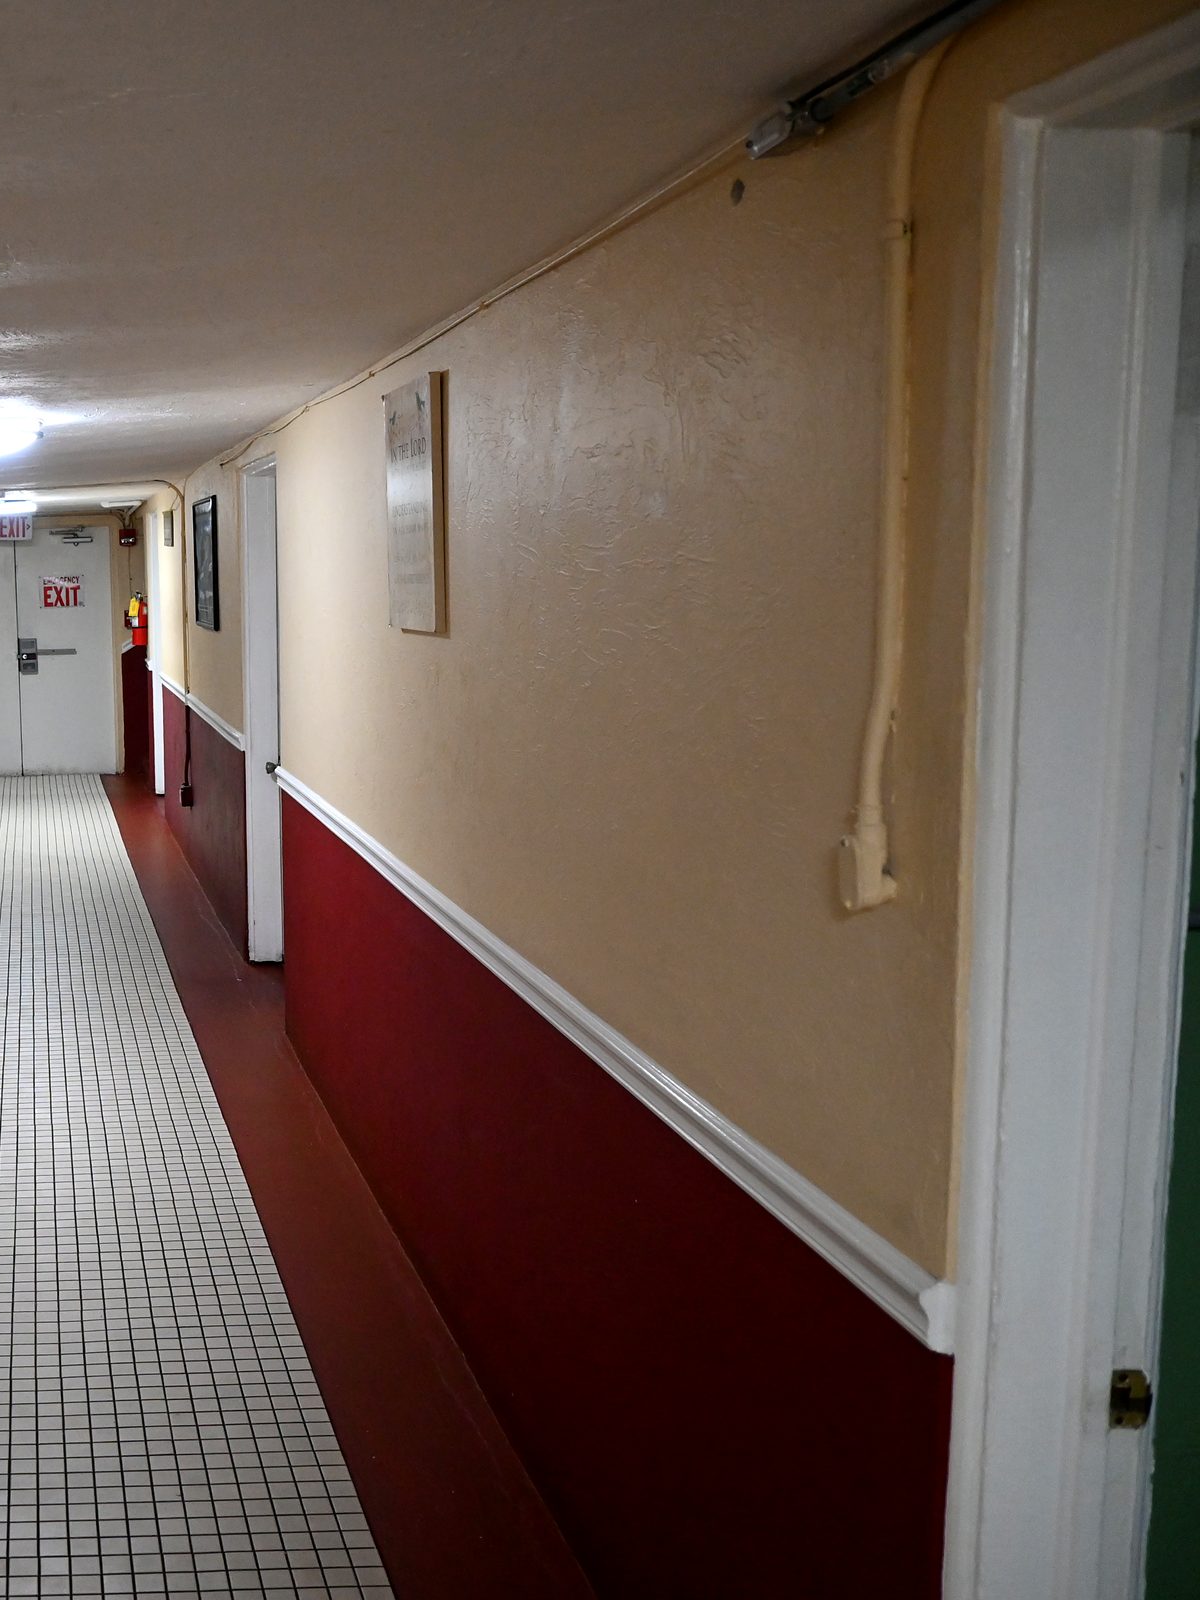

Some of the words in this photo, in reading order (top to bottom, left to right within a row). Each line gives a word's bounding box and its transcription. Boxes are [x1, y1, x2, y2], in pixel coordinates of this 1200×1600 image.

[399, 442, 409, 461] THE
[411, 434, 426, 457] LORD
[0, 516, 28, 537] EXIT
[43, 576, 80, 585] EGENCY
[43, 585, 80, 607] EXIT
